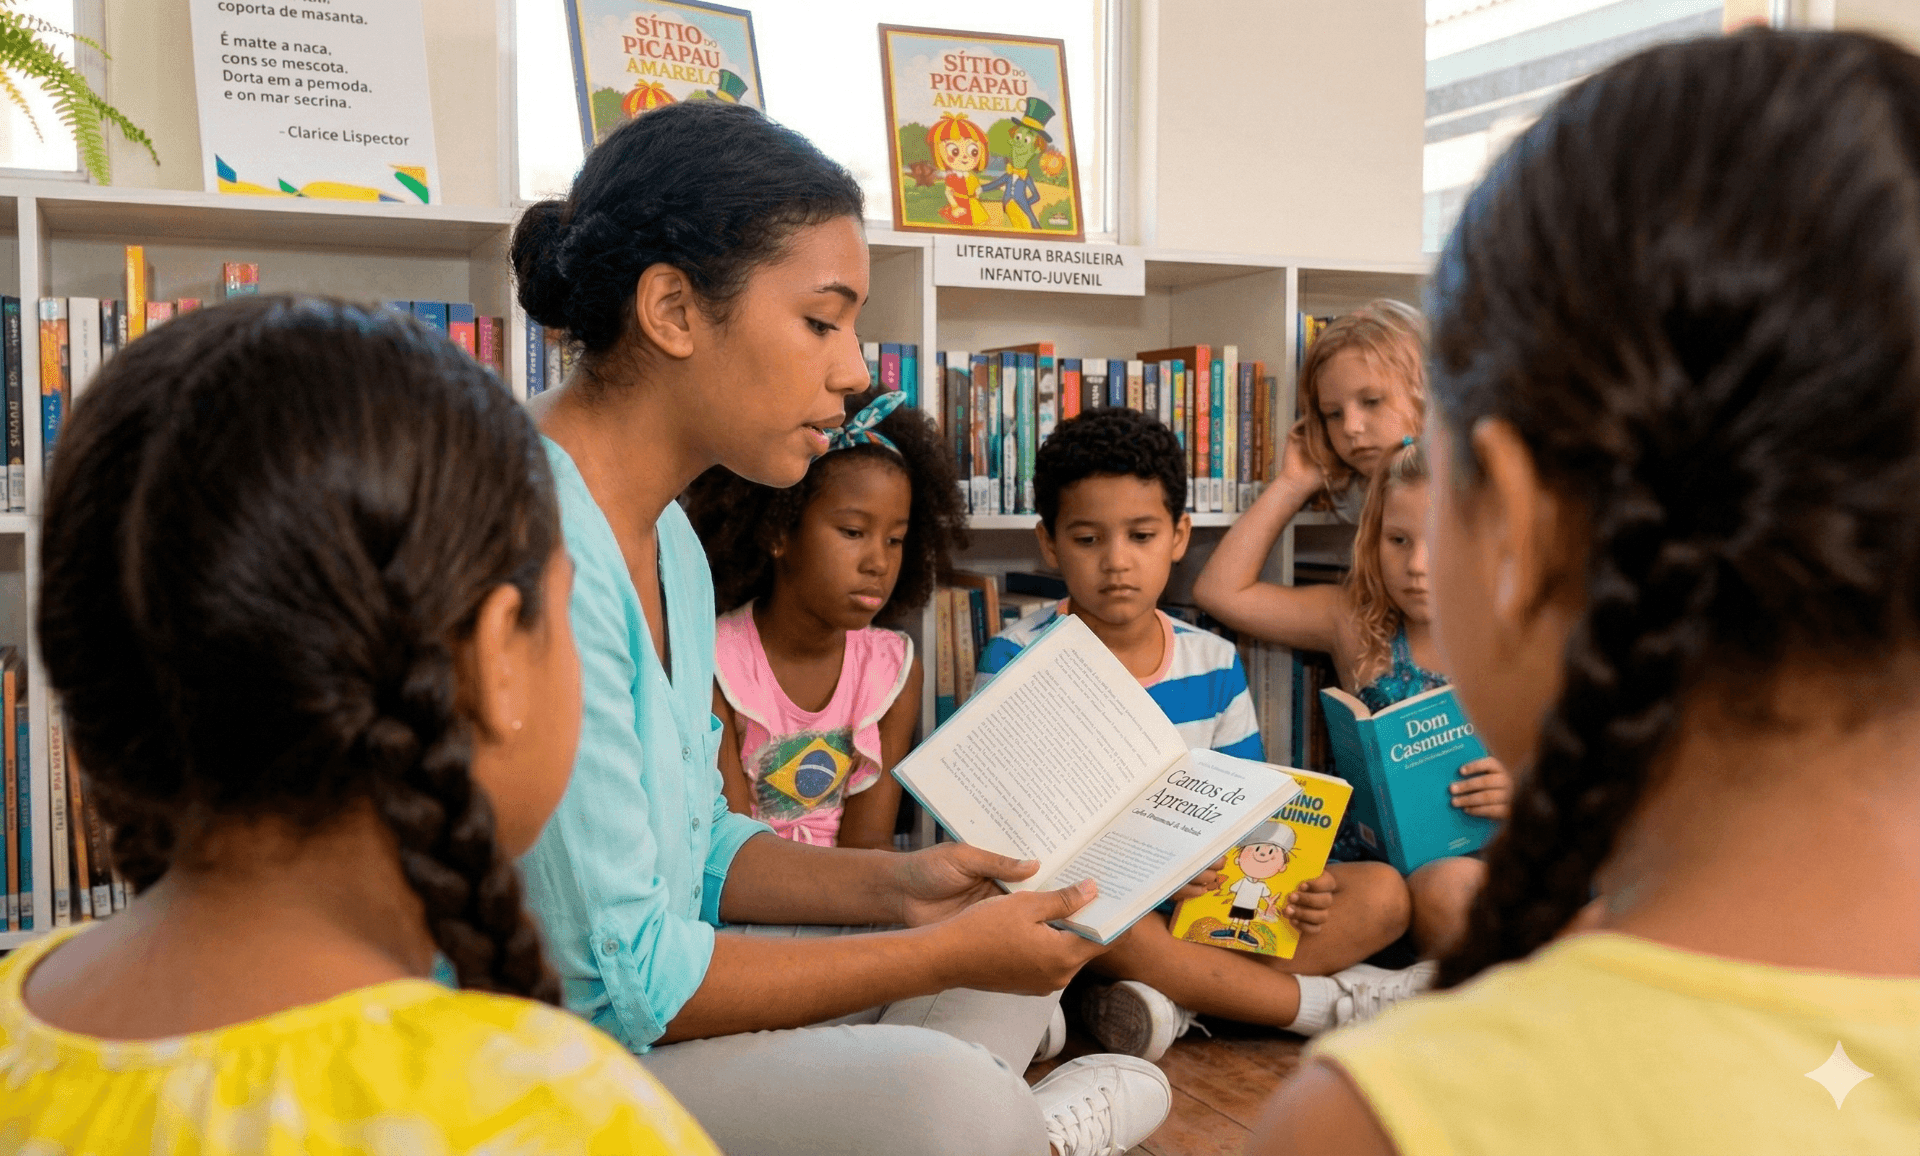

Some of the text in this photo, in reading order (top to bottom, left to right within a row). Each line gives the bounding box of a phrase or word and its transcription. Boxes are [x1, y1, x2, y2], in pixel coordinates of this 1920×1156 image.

[218, 2, 368, 24] coporta de masanta.
[220, 30, 229, 46] É
[233, 36, 277, 50] matte
[281, 42, 290, 52] a
[635, 14, 704, 45] SÍTIO
[221, 54, 258, 66] cons
[282, 59, 349, 74] mescota.
[622, 35, 721, 69] PICAPAU
[943, 50, 1011, 77] SÍTIO
[222, 69, 264, 85] Dorta
[267, 76, 290, 86] em
[294, 78, 303, 88] a
[930, 72, 1028, 97] PICAPAU
[224, 90, 352, 109] e on mar secrina.
[342, 130, 410, 147] Lispector
[956, 244, 1124, 267] LITERATURA BRASILEIRA
[980, 267, 1103, 287] INFANTO-JUVENIL
[1406, 712, 1450, 739] Dom
[1390, 722, 1475, 763] Casmurro
[1166, 769, 1220, 798] Cantos
[1220, 787, 1246, 806] de
[1146, 787, 1224, 824] Aprendiz
